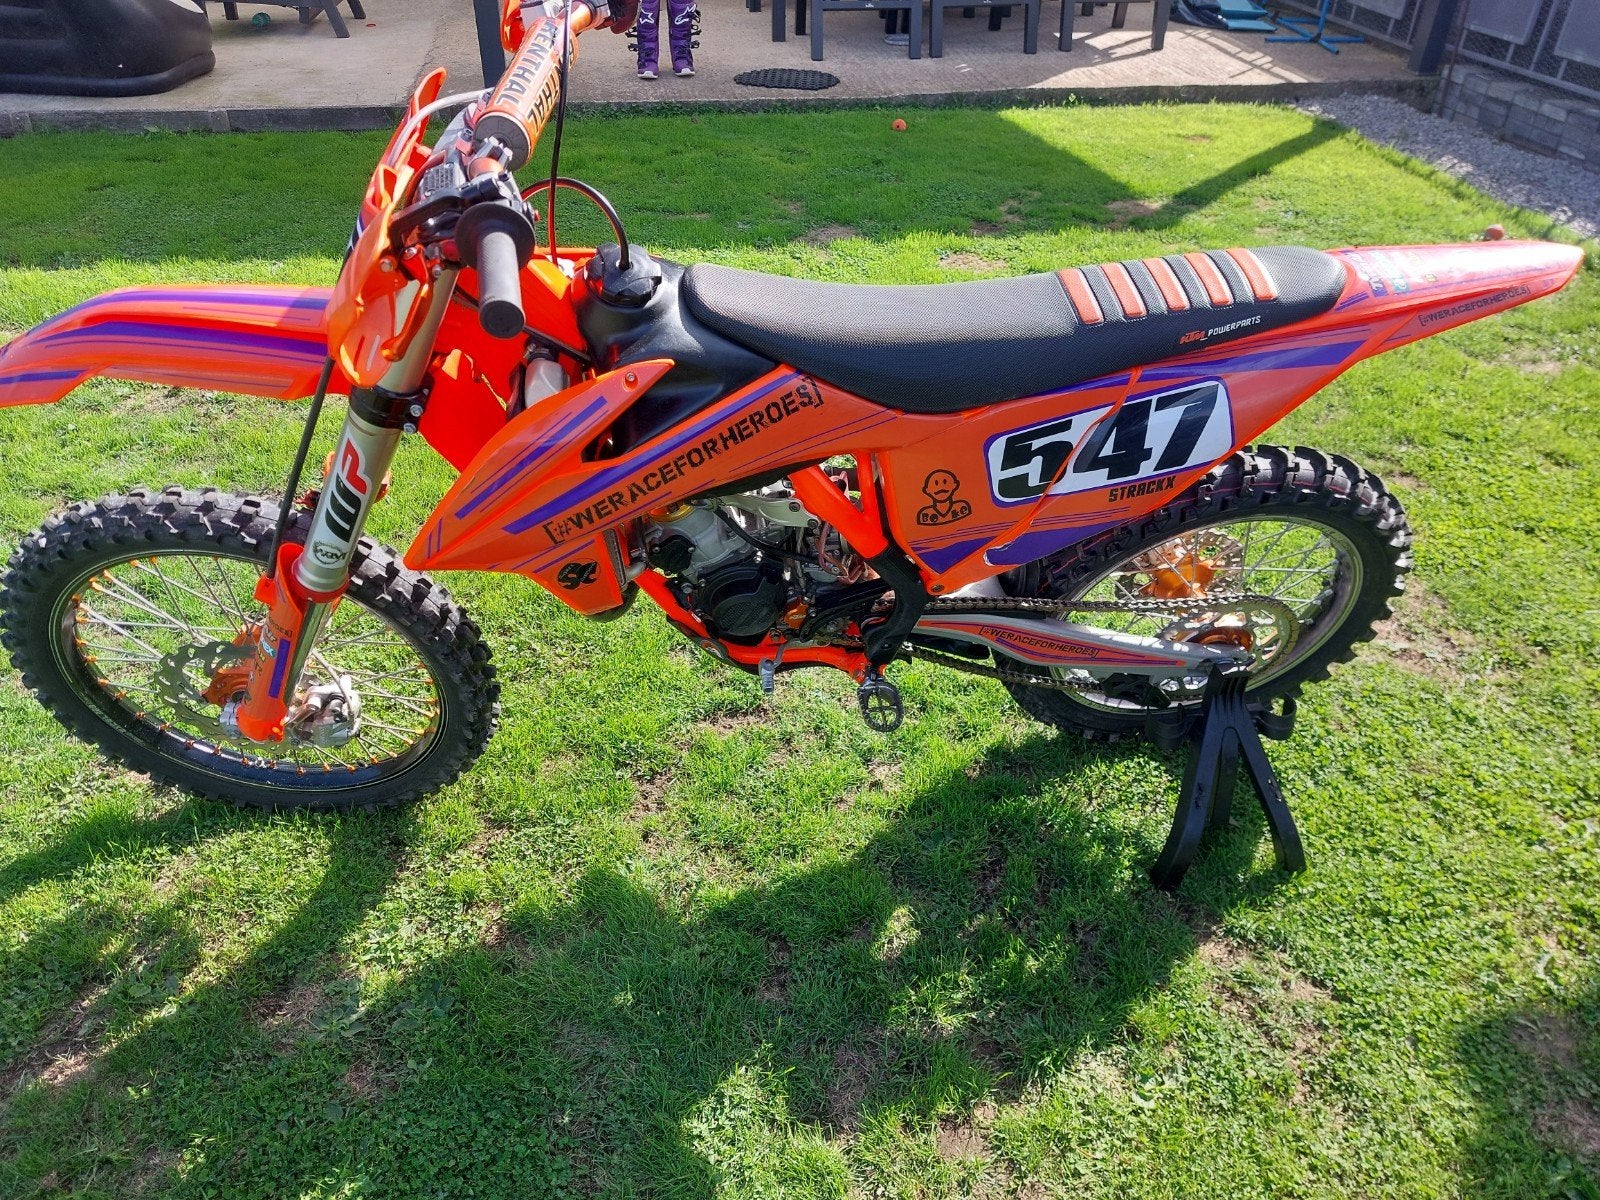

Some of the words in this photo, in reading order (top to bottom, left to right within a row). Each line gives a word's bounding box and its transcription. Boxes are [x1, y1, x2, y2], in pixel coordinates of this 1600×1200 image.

[495, 19, 559, 106] RENTHAL
[1207, 315, 1261, 337] POWERPARTS
[998, 383, 1219, 499] 547
[325, 437, 368, 543] WP
[1108, 475, 1177, 502] STRACKX
